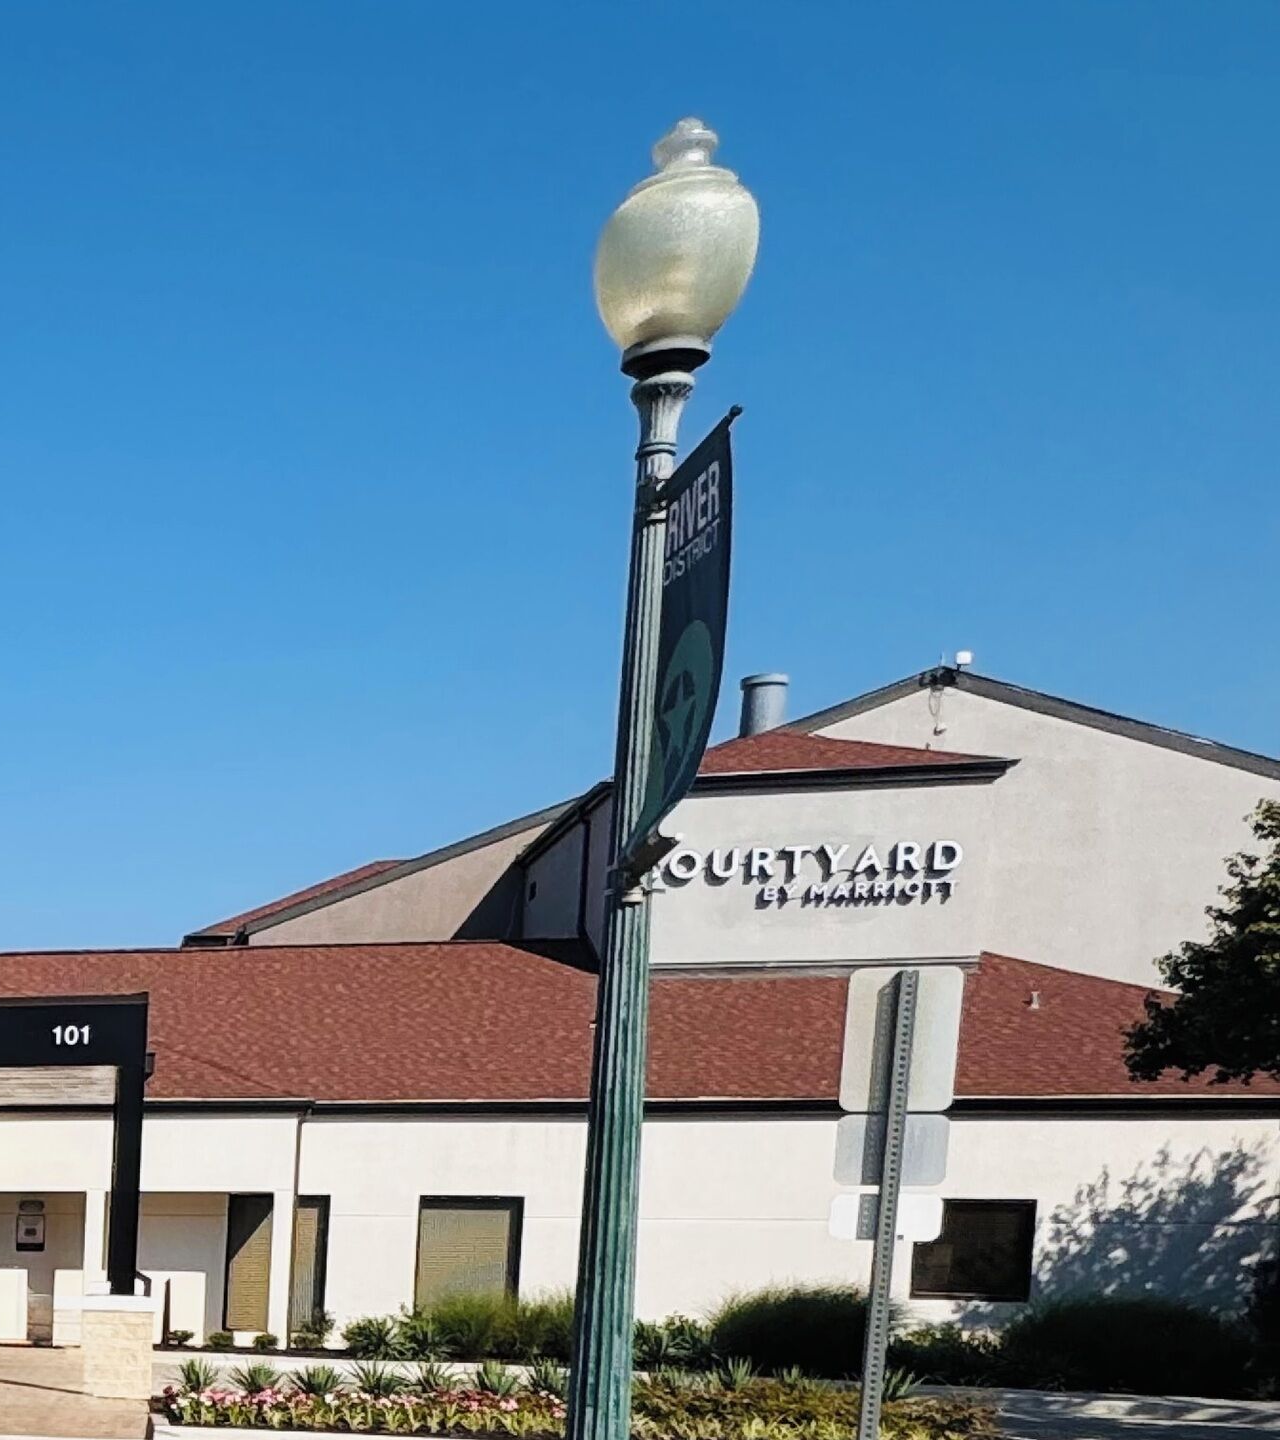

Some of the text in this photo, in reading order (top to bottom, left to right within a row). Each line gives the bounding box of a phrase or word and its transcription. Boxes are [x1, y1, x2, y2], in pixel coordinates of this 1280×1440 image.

[666, 461, 720, 558] RIVER
[663, 519, 720, 586] DISTRICT
[653, 840, 963, 879] OURTYARD
[762, 879, 960, 901] BY MARRIOTT
[52, 1025, 90, 1045] 101
